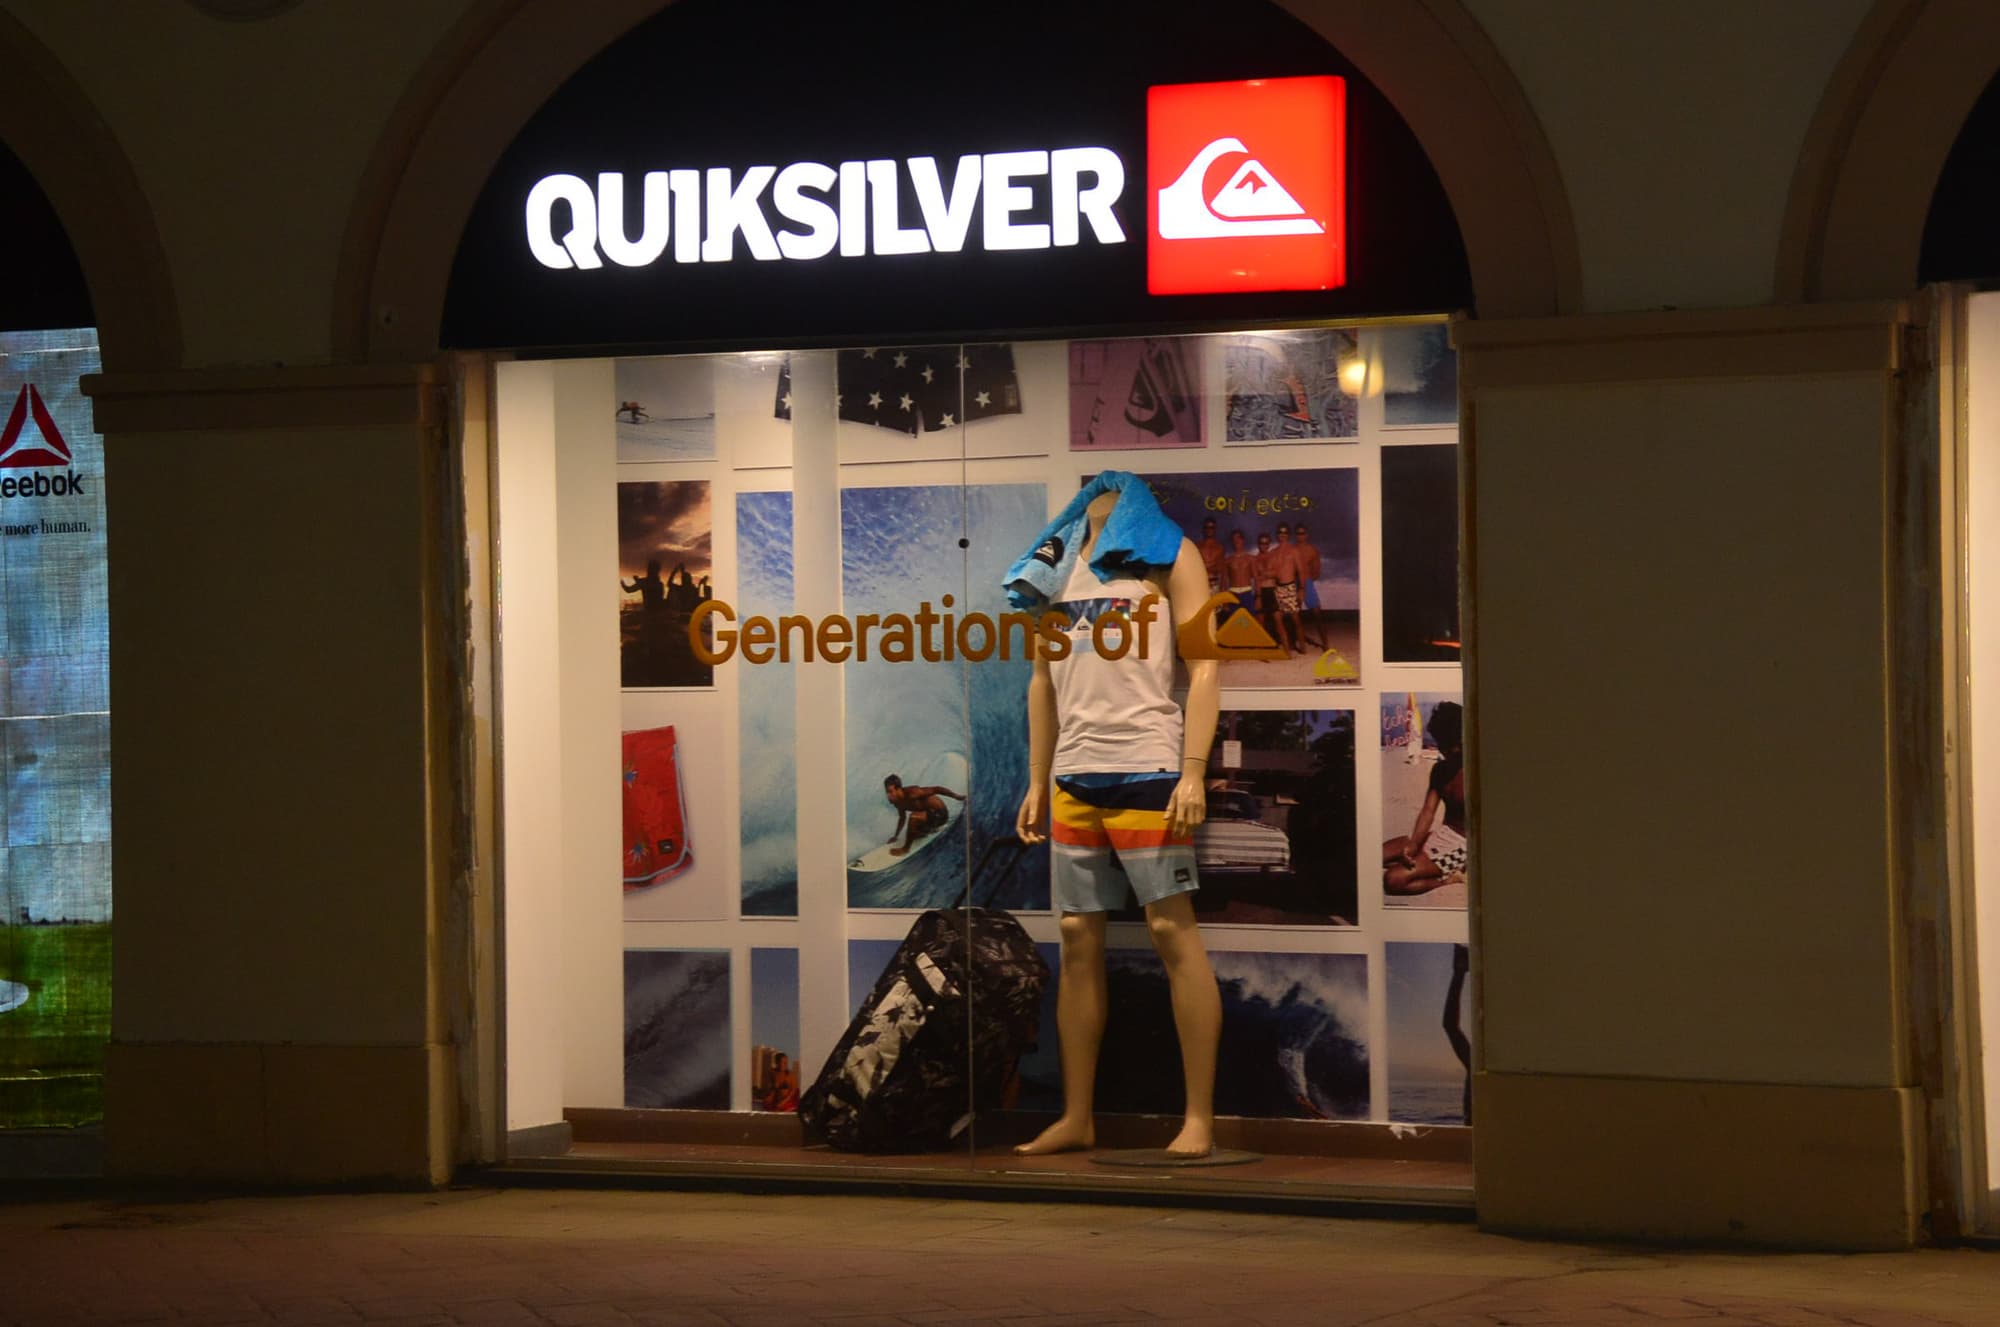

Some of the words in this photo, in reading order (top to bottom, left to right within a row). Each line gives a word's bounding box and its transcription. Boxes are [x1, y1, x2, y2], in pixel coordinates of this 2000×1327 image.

[525, 146, 1127, 269] QUIKSILVER
[0, 469, 84, 498] eebok
[5, 522, 39, 537] more
[40, 517, 91, 535] human.
[688, 594, 1072, 665] Generations
[1092, 593, 1160, 662] of
